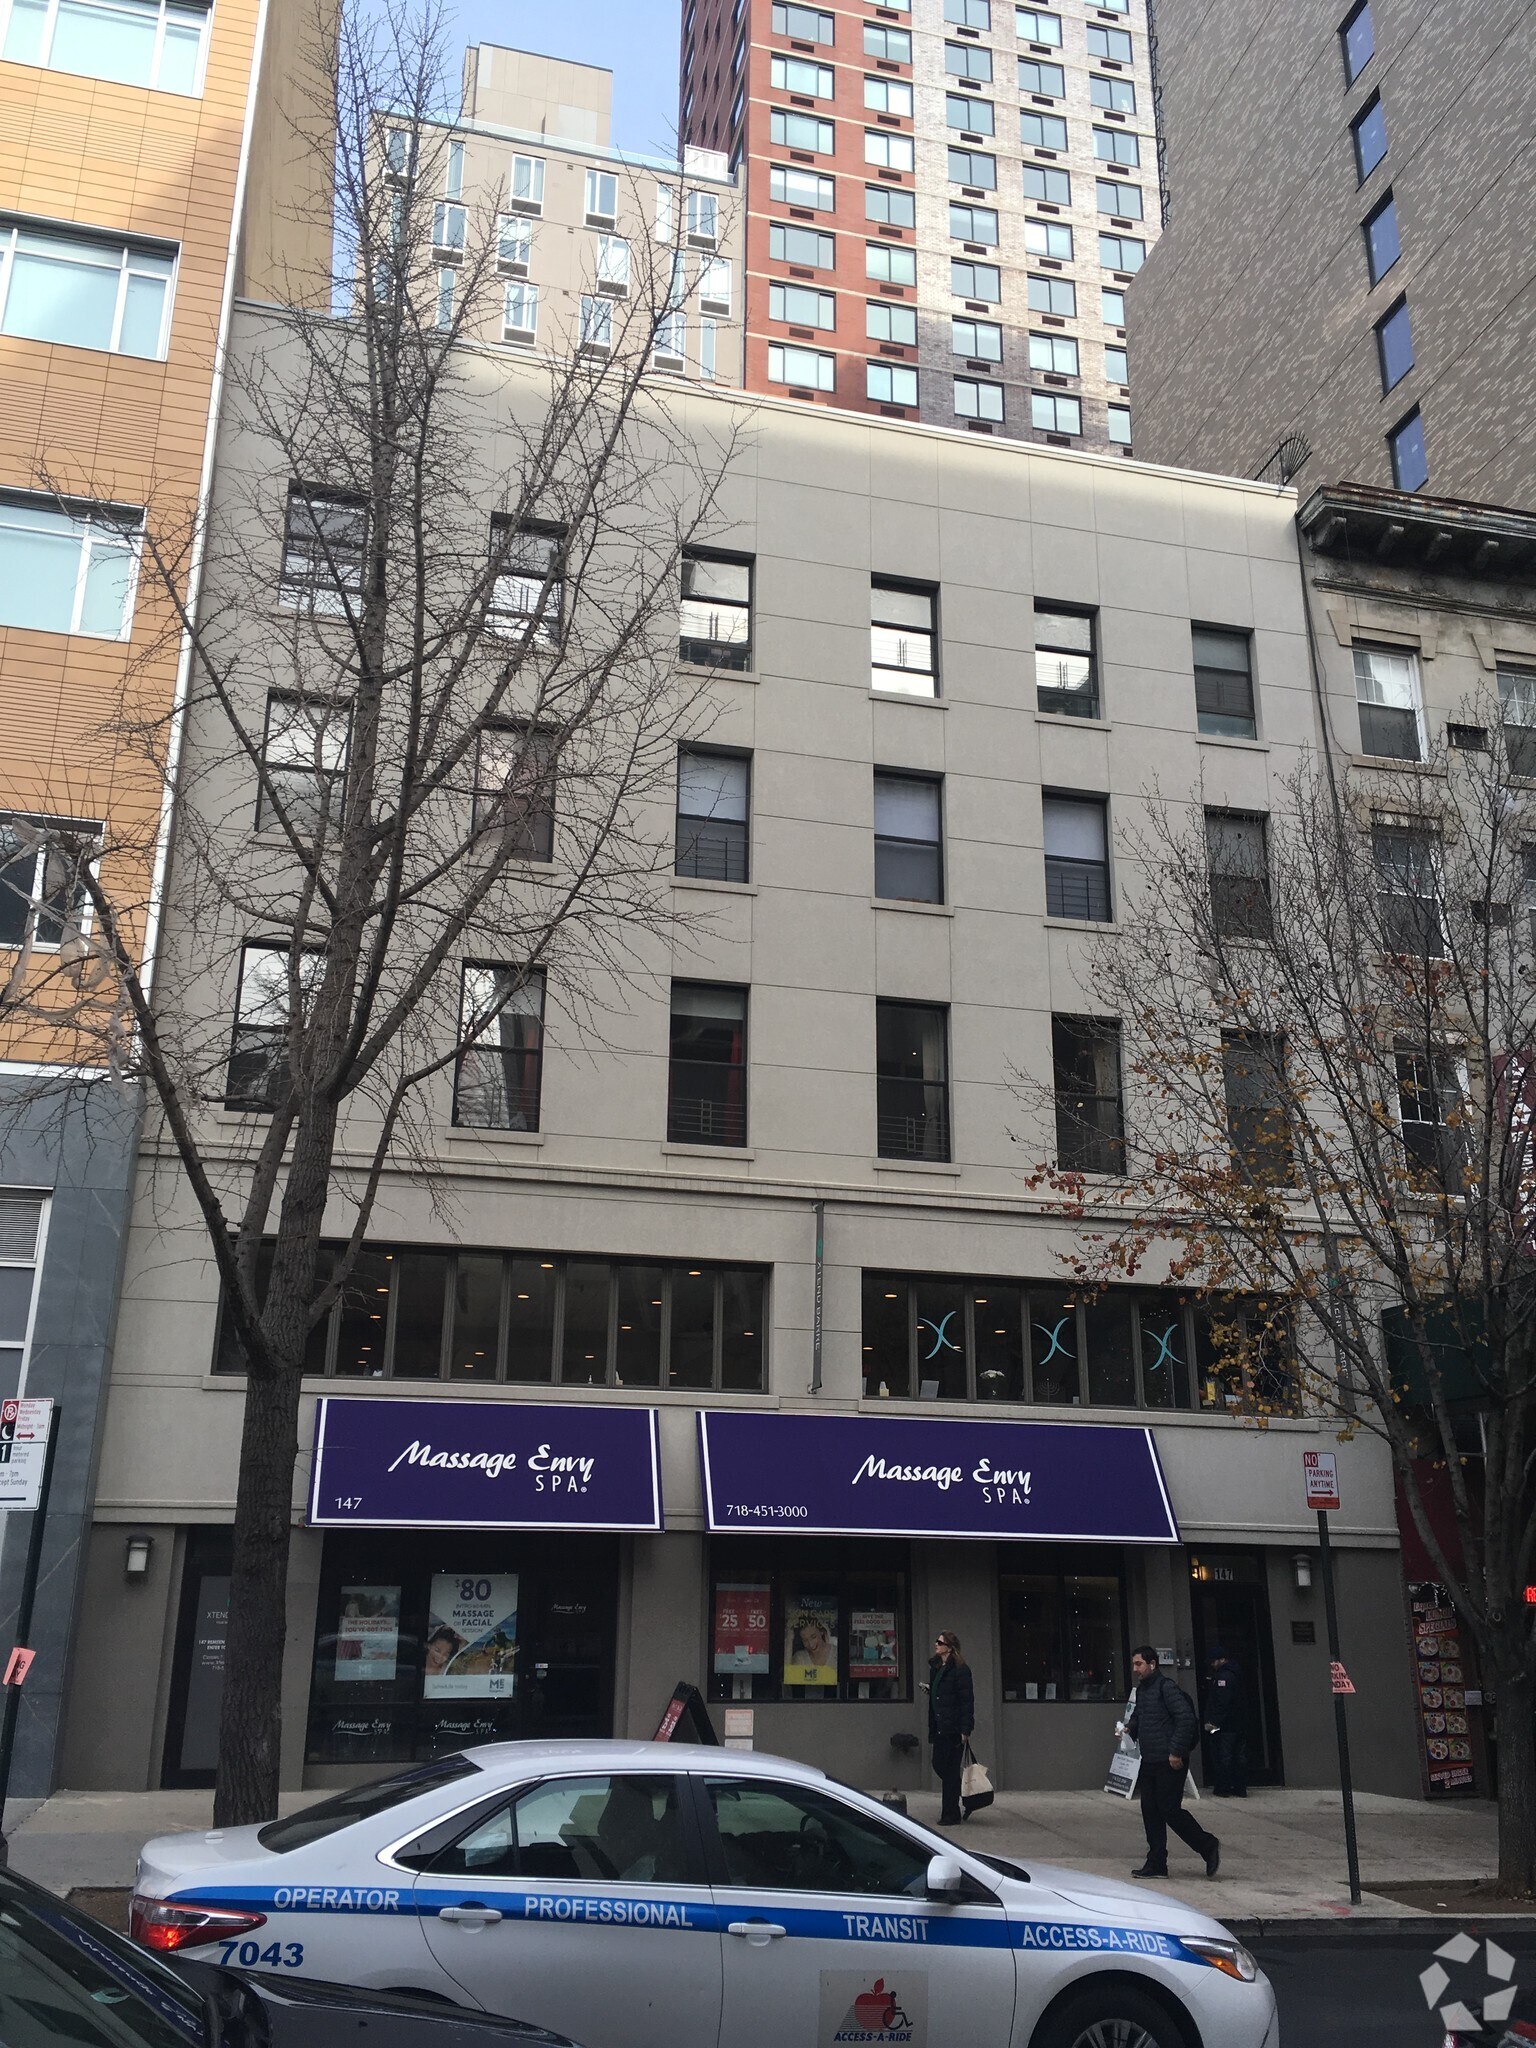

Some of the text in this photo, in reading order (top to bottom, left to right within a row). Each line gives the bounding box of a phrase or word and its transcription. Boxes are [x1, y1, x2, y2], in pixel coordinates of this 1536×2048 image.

[2, 1444, 6, 1461] 1
[388, 1440, 594, 1482] Massage Envy
[1305, 1454, 1318, 1466] NO
[852, 1454, 1031, 1494] Massage Envy
[1309, 1470, 1333, 1478] PARKING
[335, 1498, 362, 1510] 147
[726, 1504, 808, 1518] 718-451-3000
[1215, 1568, 1232, 1580] 147
[801, 1598, 822, 1608] New
[332, 1720, 369, 1731] Massage
[434, 1719, 470, 1731] Massage
[274, 1888, 1171, 1956] OPERATOR PROFESSIONAL TRANSIT ACCESS-A-RIDE
[218, 1942, 304, 1968] 7043
[834, 2033, 912, 2041] ACCESS-A-RIDE
